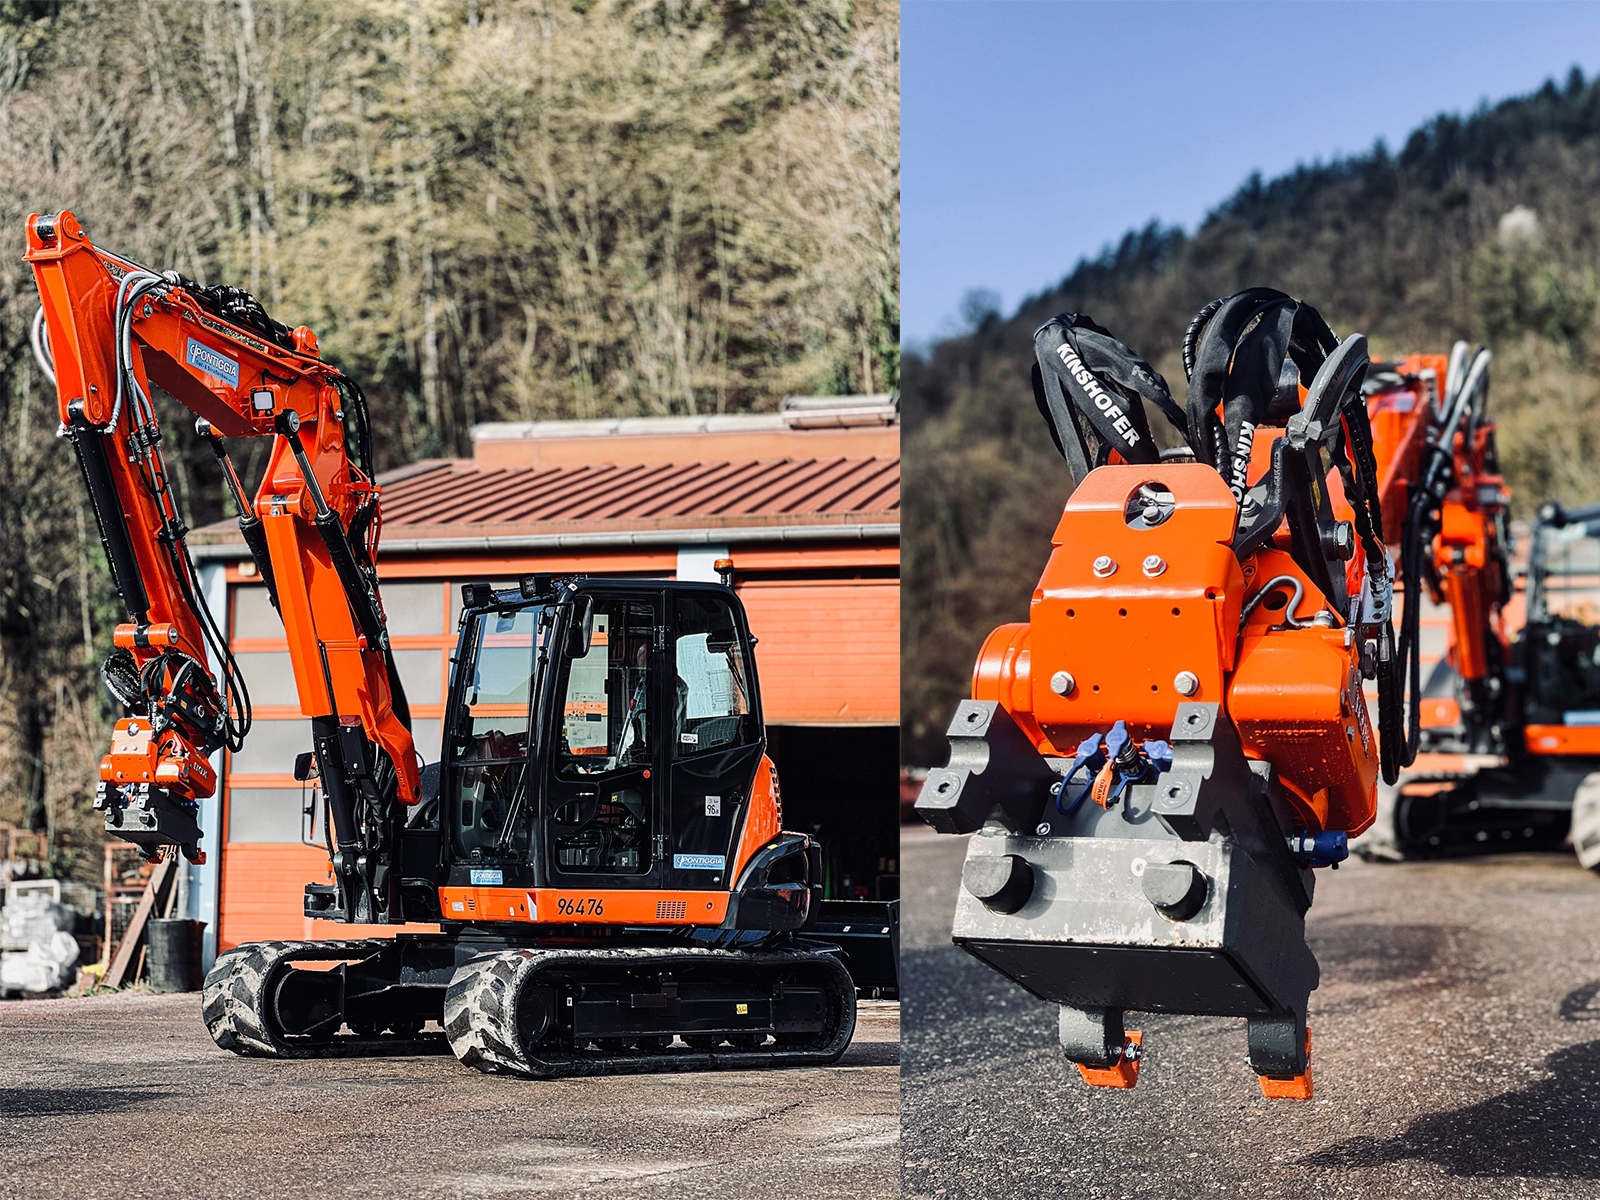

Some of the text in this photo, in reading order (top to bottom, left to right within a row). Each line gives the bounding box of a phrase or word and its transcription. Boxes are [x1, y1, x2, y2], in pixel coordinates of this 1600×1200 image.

[193, 345, 237, 377] PONTIGGIA
[1057, 343, 1140, 447] KINSHOFER
[1230, 421, 1255, 503] KINSHO
[680, 857, 722, 865] PONTIGGIA
[558, 899, 604, 916] 96476
